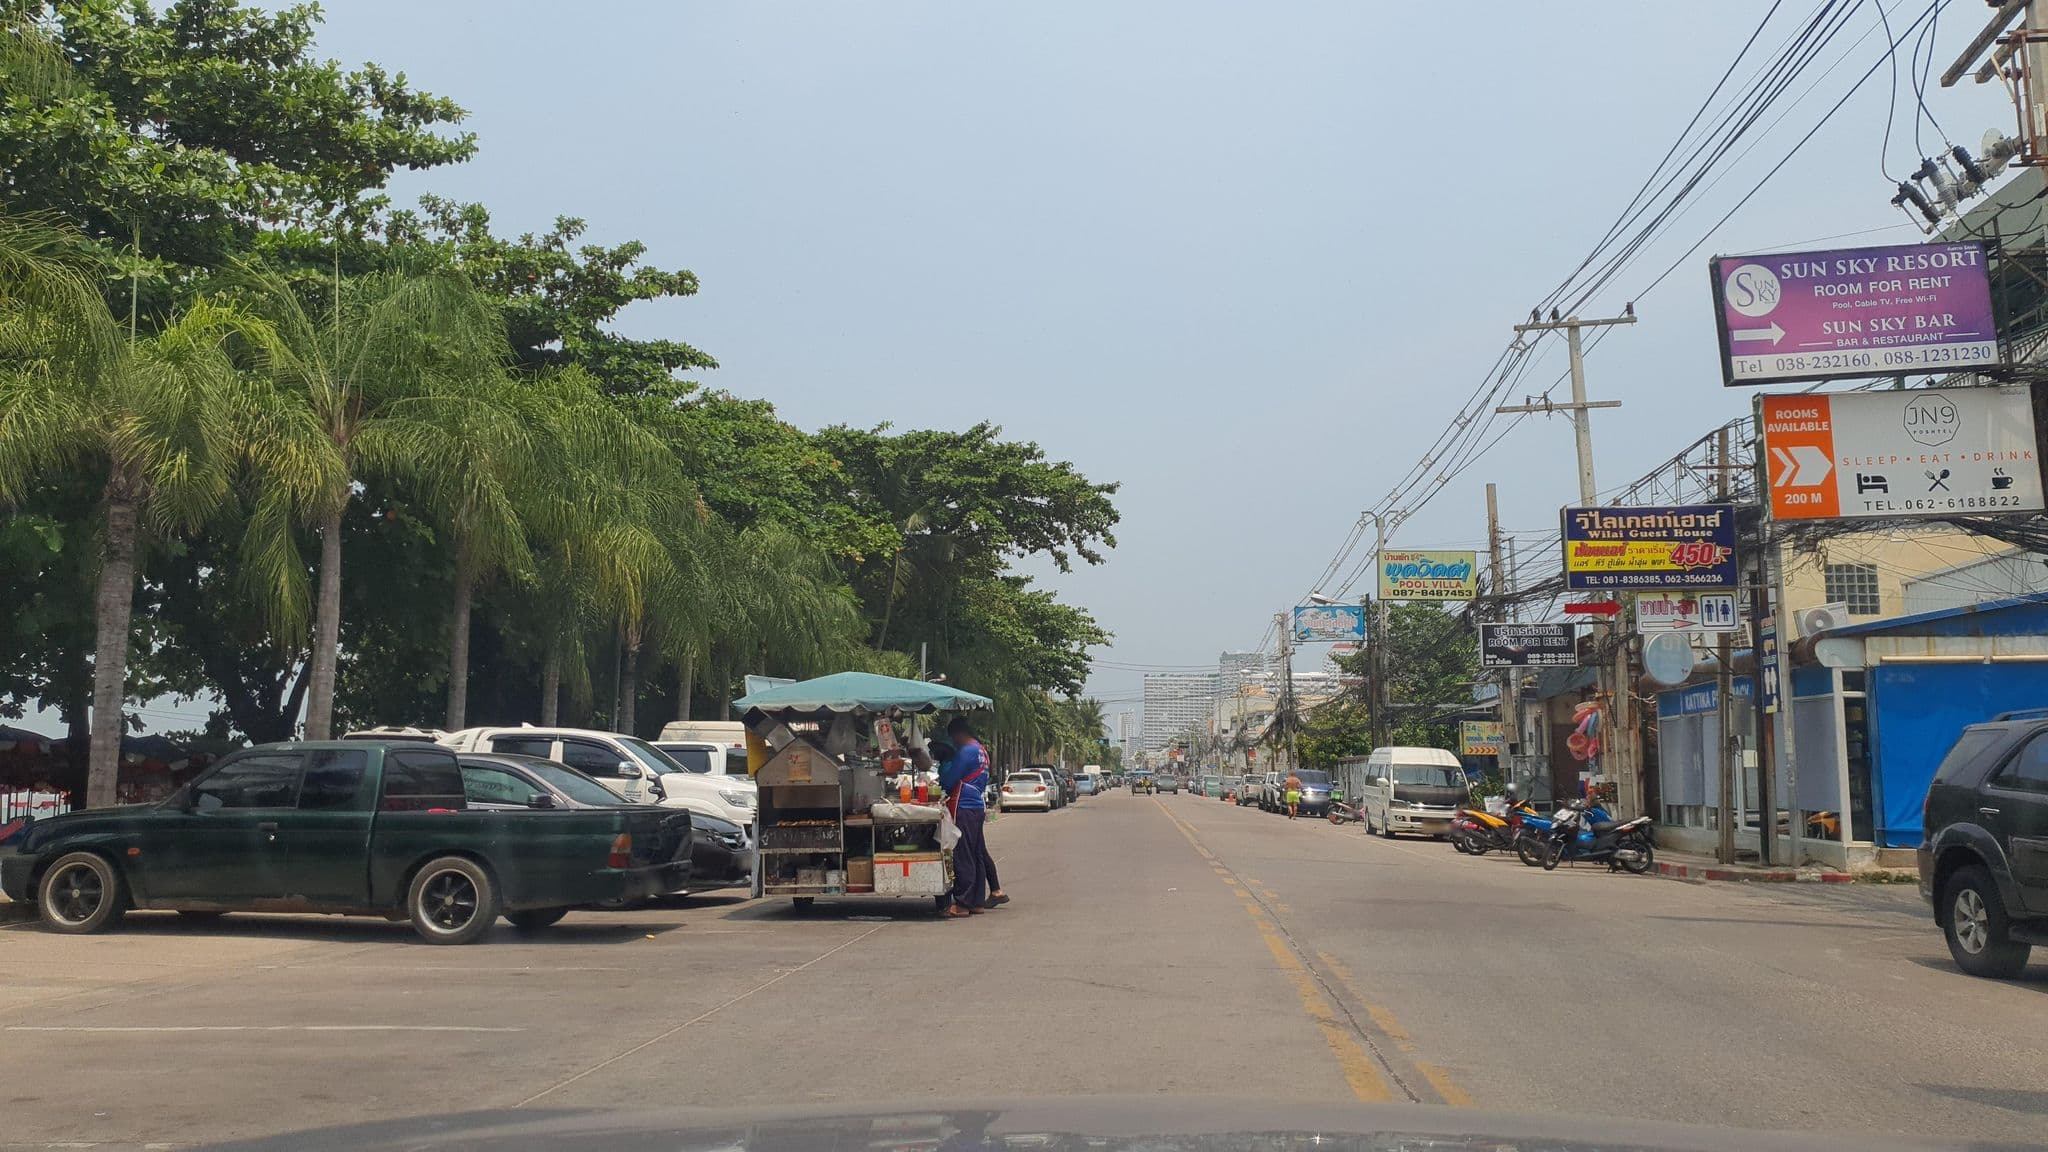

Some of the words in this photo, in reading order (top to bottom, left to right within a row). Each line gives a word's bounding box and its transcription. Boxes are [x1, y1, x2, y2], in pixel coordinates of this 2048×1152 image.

[1781, 262, 1827, 279] SUN
[1836, 258, 1878, 275] SKY
[1888, 250, 1979, 272] RESORT
[1814, 282, 1862, 297] ROOM
[1869, 280, 1902, 293] FOR
[1909, 276, 1952, 290] RENT
[1855, 299, 1878, 308] Cable
[1916, 295, 1937, 303] Wi-Fi
[1823, 320, 1862, 334] SUN
[1870, 316, 1907, 332] SKY
[1915, 313, 1956, 328] BAR
[1837, 338, 1858, 347] BAR
[1862, 337, 1869, 345] &
[1873, 332, 1943, 345] RESTAURANT
[1737, 359, 1763, 373] Tel
[1884, 345, 1991, 365] 088-1231230
[1776, 408, 1818, 420] ROOMS
[1908, 405, 1955, 426] JN9
[1768, 421, 1830, 432] AVAILABLE
[1843, 455, 1898, 466] SLEEP
[1920, 453, 1951, 464] EAT
[1974, 450, 2033, 461] DRINK
[1785, 493, 1811, 504] 200
[1812, 493, 1822, 503] M
[1588, 529, 1624, 538] Wilai
[1629, 529, 1668, 538] Guest
[1674, 528, 1713, 537] House
[1399, 581, 1428, 589] POOL
[1432, 580, 1462, 589] VILLA
[1586, 576, 1600, 584] TEL:
[1488, 637, 1518, 647] ROOM
[1520, 637, 1541, 647] FOR
[1543, 636, 1569, 646] RENT
